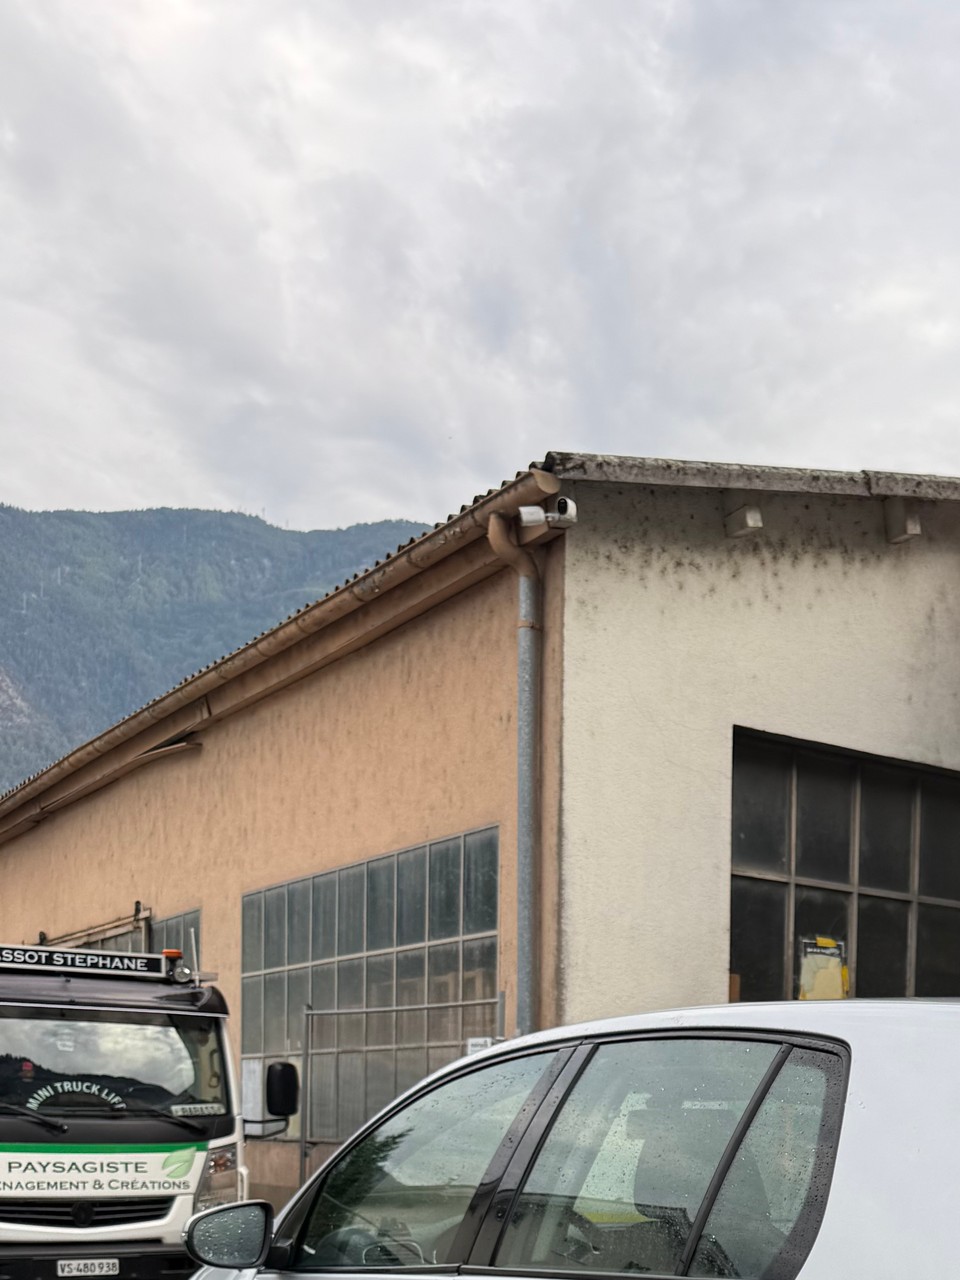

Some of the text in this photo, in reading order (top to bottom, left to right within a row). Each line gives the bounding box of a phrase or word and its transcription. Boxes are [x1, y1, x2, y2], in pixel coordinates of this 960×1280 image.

[0, 949, 149, 971] SSOT STEPHANE
[25, 1085, 55, 1111] MINI
[54, 1081, 101, 1096] TRUCK
[7, 1161, 149, 1174] PAYSAGISTE
[0, 1180, 89, 1191] NAGEMENT
[92, 1179, 105, 1191] &
